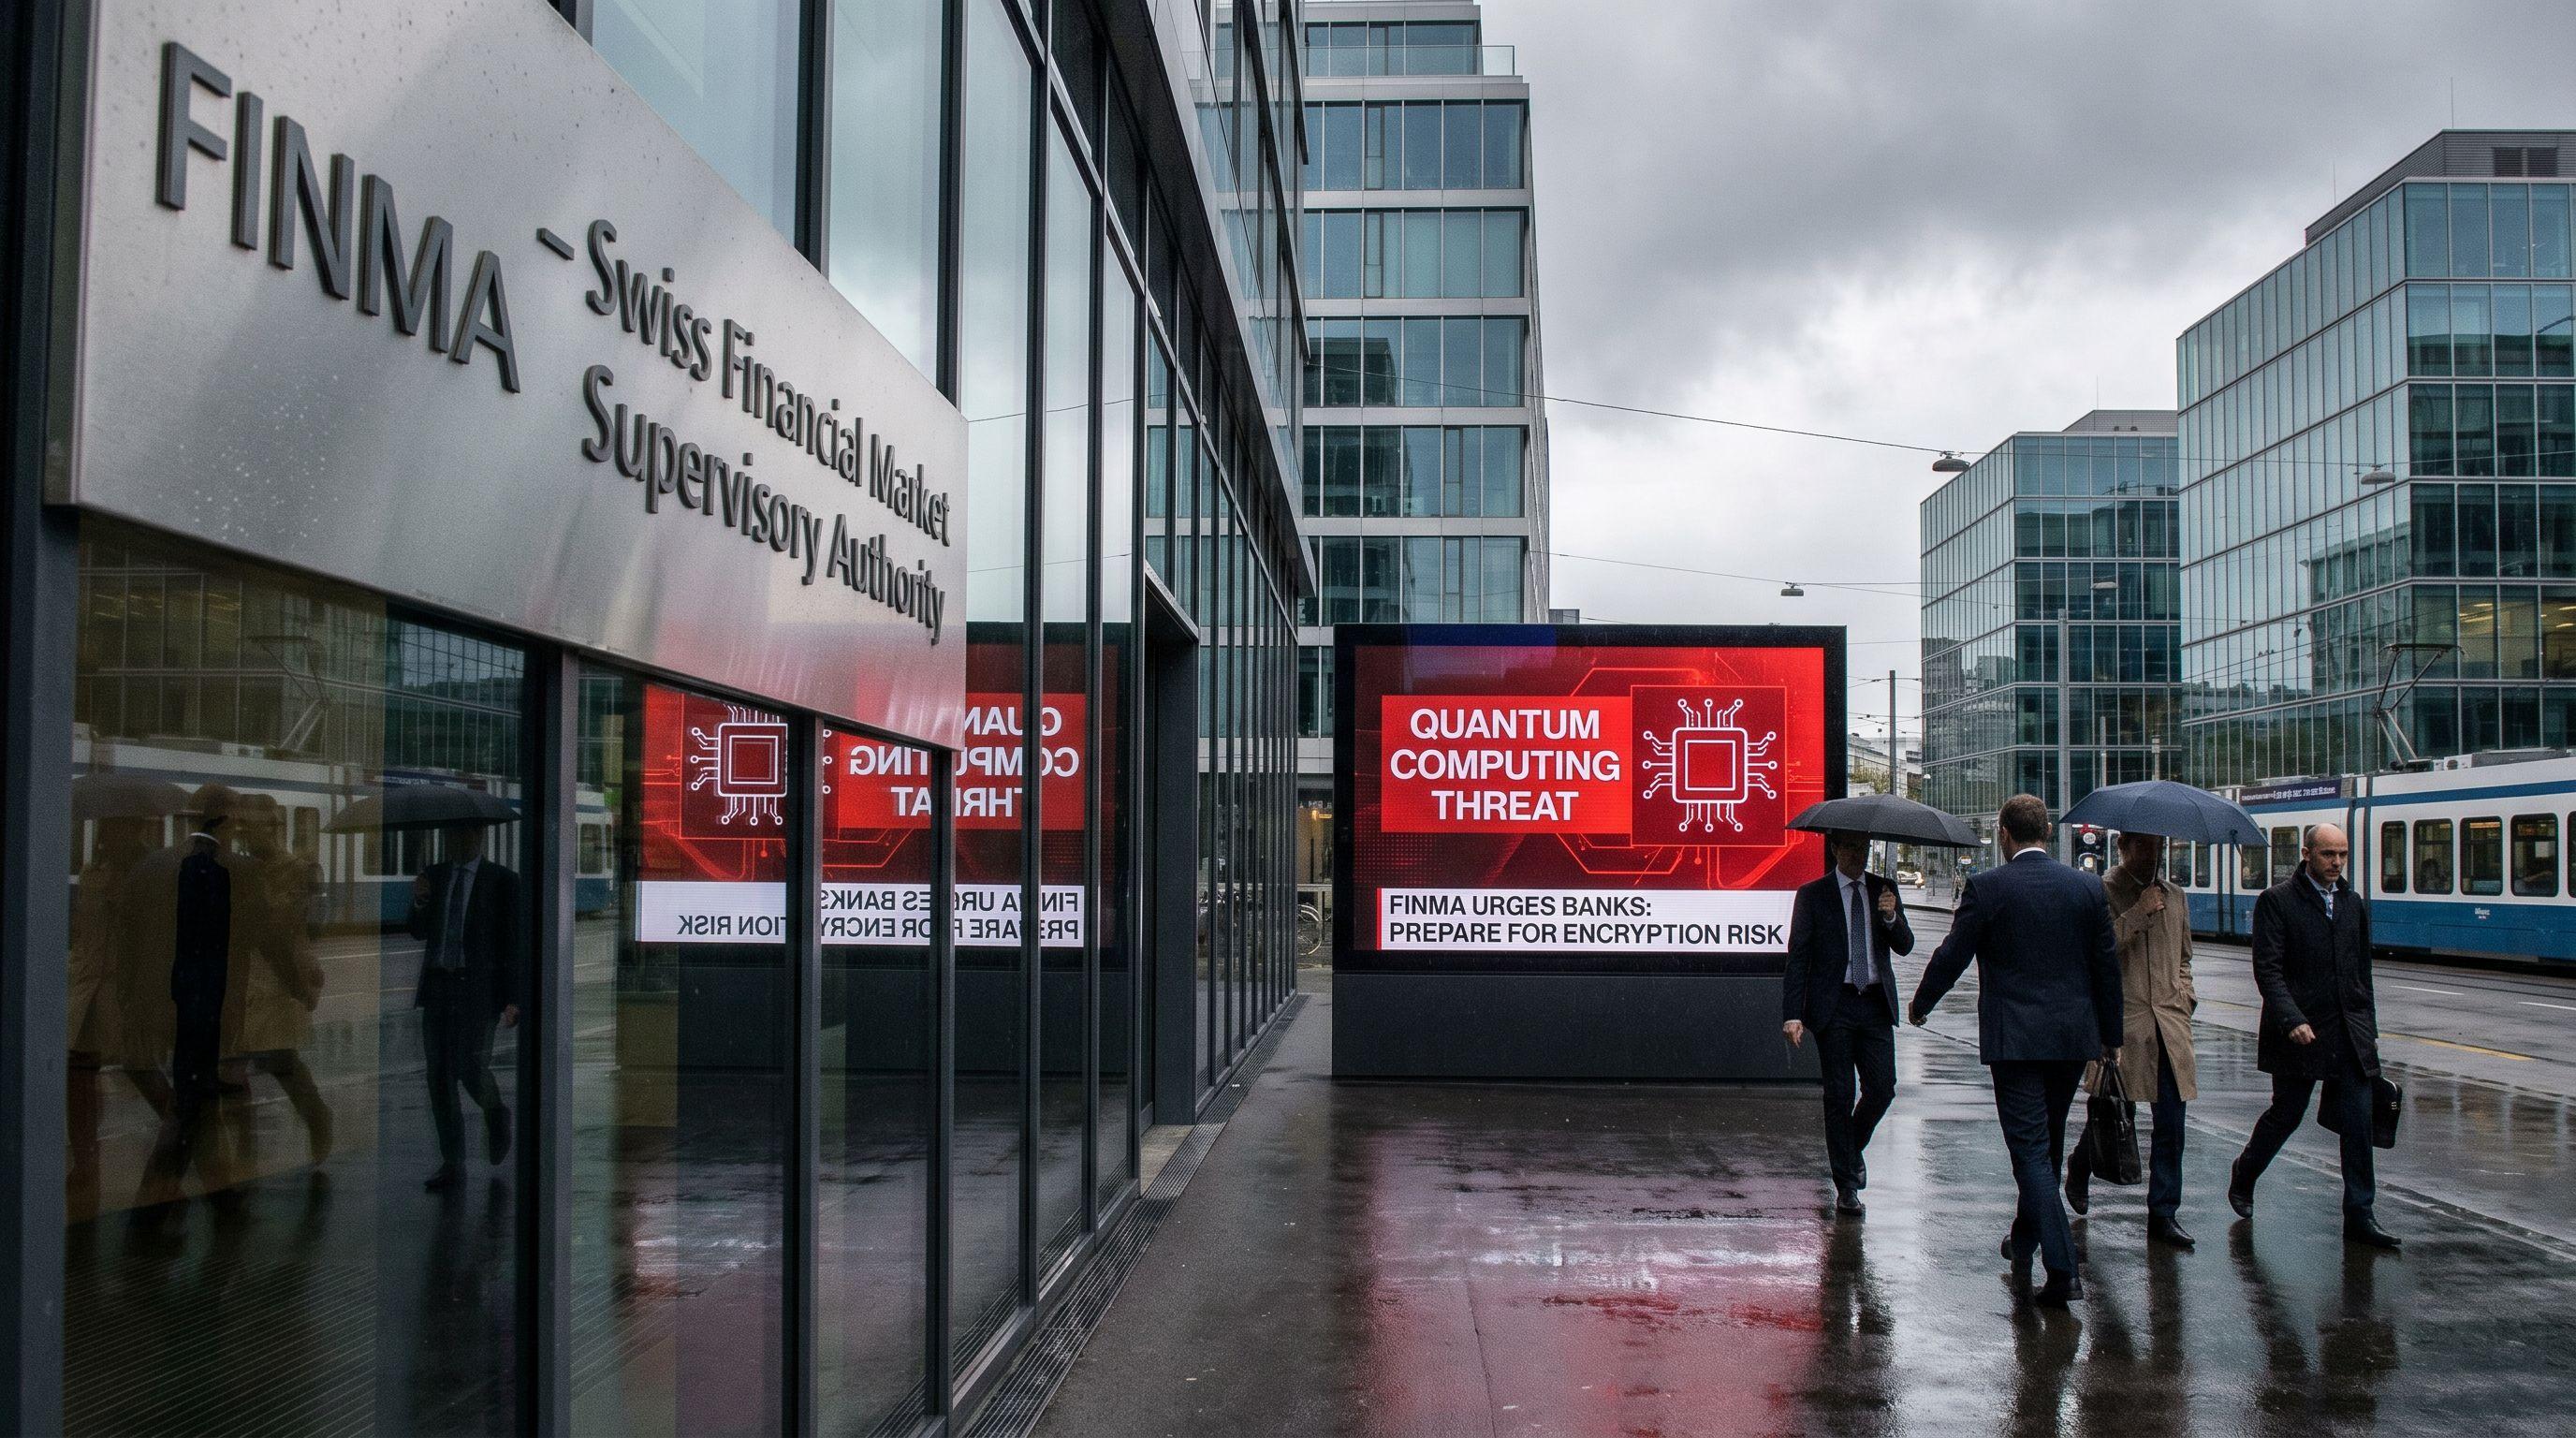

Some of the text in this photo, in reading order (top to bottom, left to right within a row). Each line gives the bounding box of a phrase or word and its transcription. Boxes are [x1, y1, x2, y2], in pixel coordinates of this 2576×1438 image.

[154, 41, 520, 395] FINMA
[584, 218, 713, 383] Swiss
[722, 318, 863, 489] Financial
[869, 433, 951, 549] Market
[580, 362, 945, 647] Supervisory Authority
[1410, 709, 1601, 741] QUANTUM
[1391, 749, 1621, 782] COMPUTING
[1431, 790, 1580, 822] THREAT
[1390, 894, 1652, 917] FINMA URGES BANKS:
[1390, 923, 1784, 946] PREPARE FOR ENCRYPTION RISK
